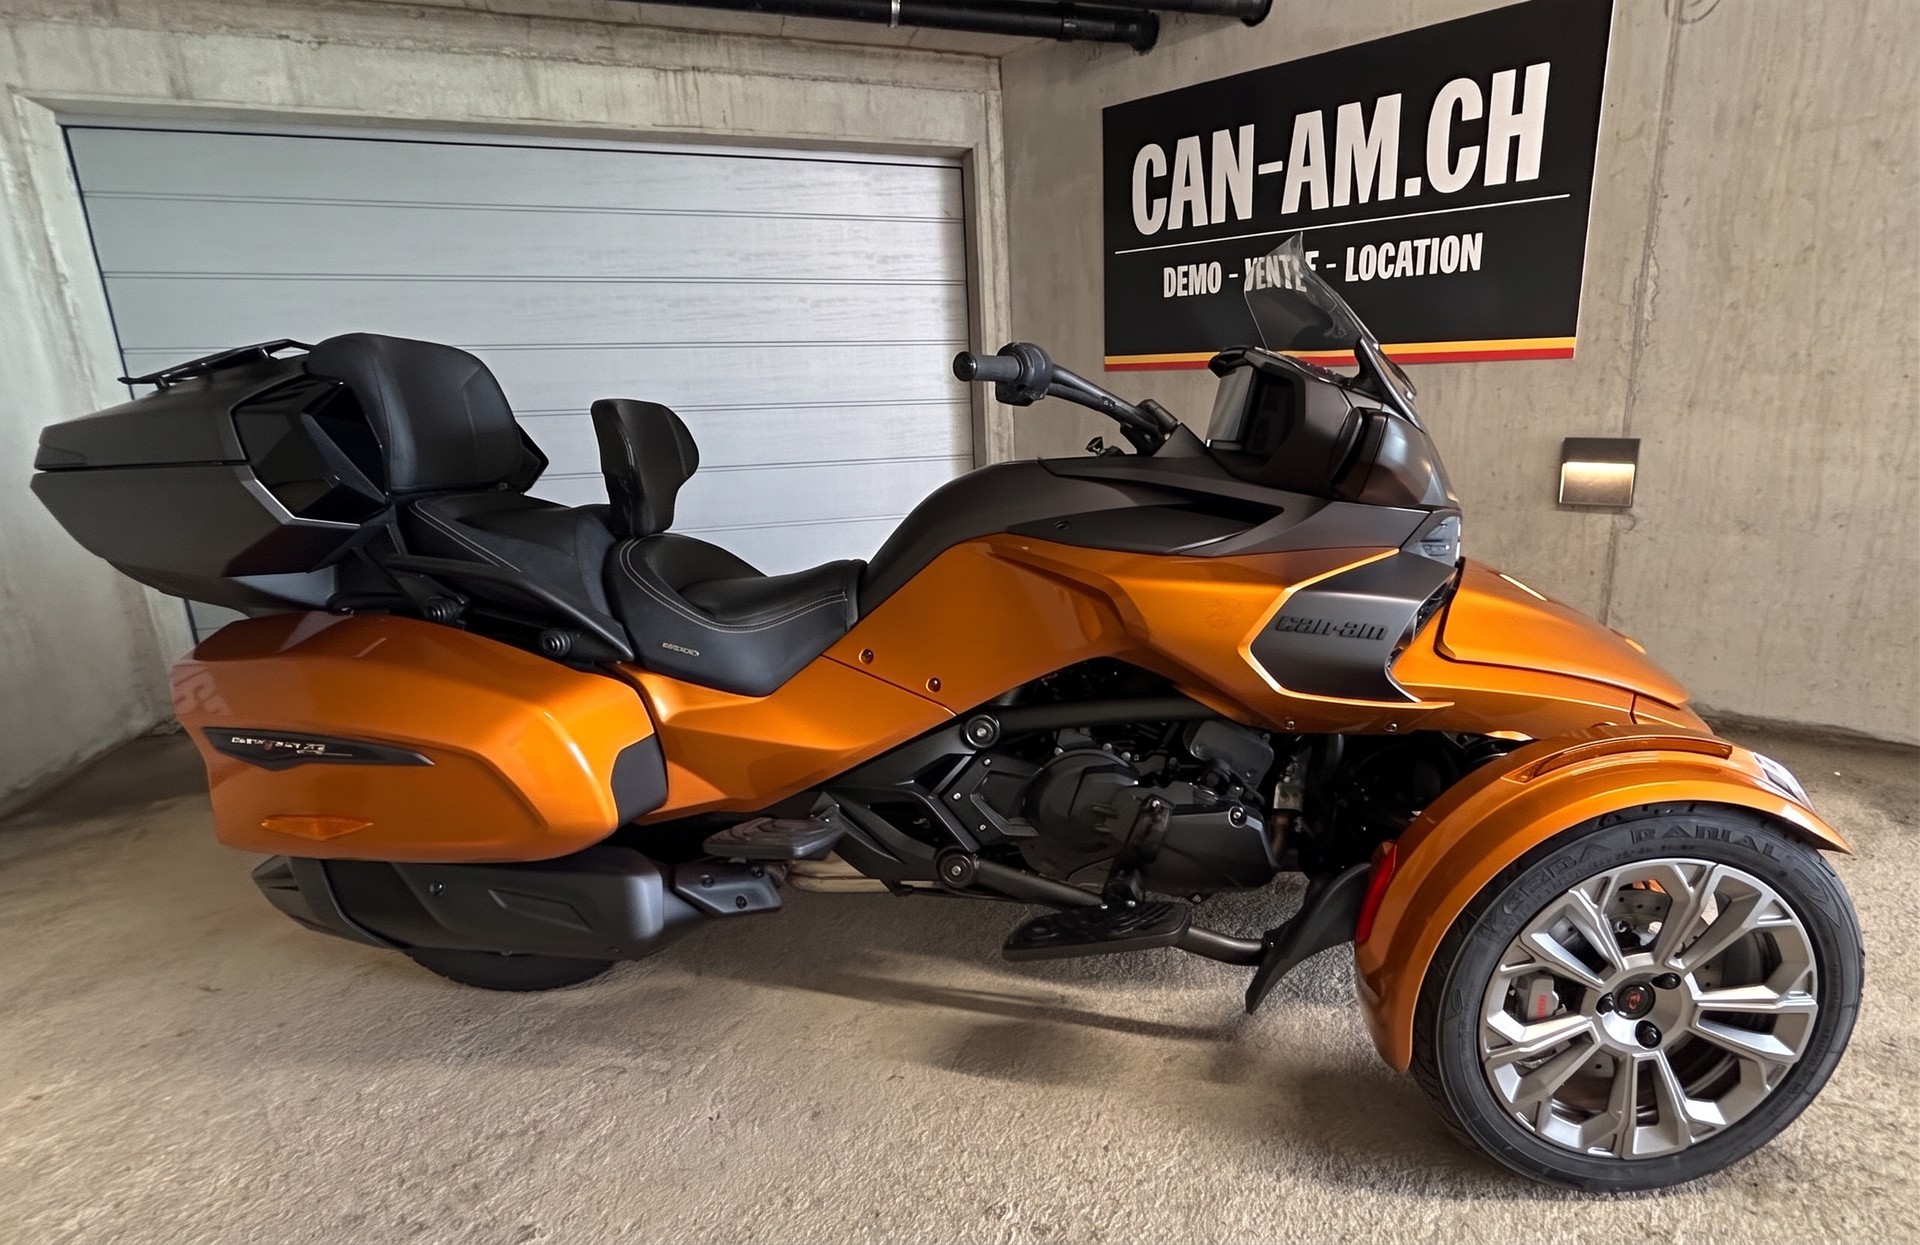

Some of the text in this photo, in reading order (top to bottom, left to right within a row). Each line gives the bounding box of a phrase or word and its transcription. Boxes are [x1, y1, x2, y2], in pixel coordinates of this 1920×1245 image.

[1132, 62, 1551, 236] CAN-AM.CH
[1163, 261, 1222, 298] DEMO
[1344, 232, 1484, 283] LOCATION
